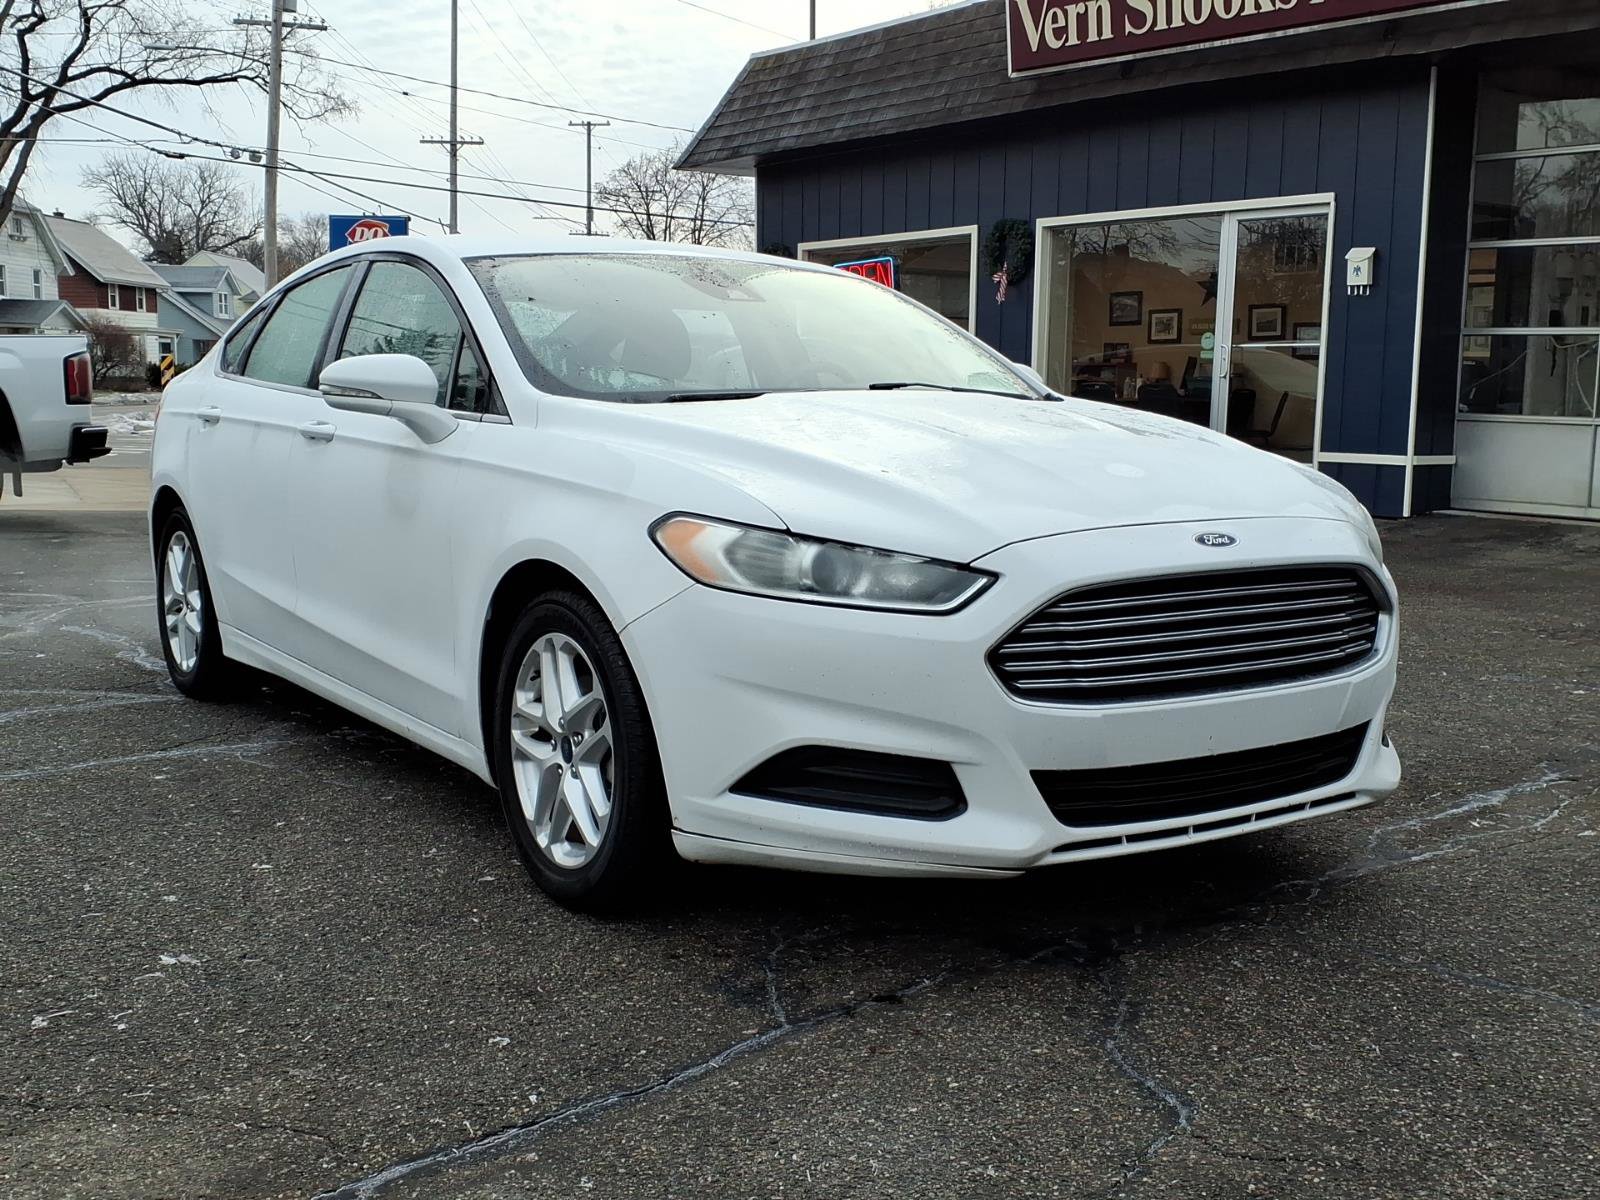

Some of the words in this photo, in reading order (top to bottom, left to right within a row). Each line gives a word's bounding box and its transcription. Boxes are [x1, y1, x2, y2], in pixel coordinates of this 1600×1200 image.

[1015, 0, 1114, 52] Vern
[1124, 0, 1298, 36] Sno
[840, 262, 892, 289] EN
[1203, 534, 1231, 545] Ford
